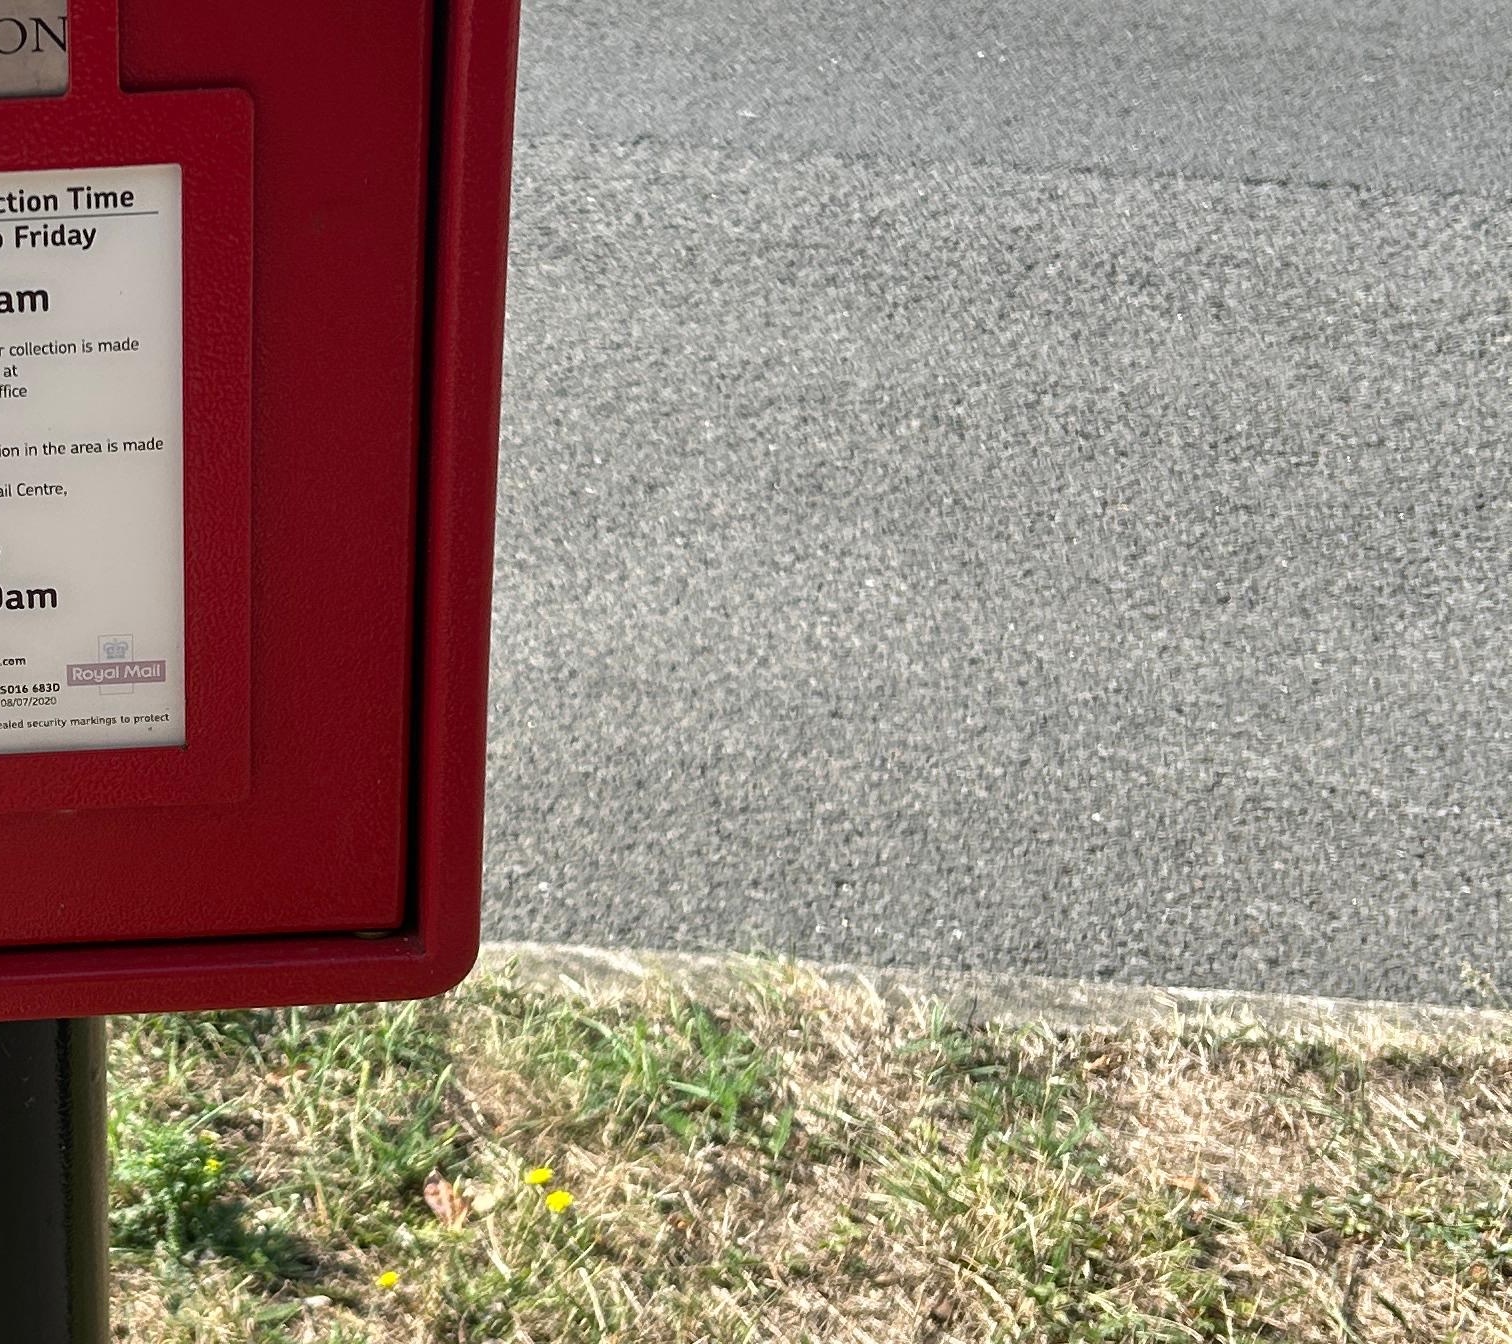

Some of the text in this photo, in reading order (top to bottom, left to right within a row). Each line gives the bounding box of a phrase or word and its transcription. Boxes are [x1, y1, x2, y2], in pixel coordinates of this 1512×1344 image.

[67, 186, 134, 210] Time
[15, 224, 97, 249] Friday
[9, 340, 77, 356] collection
[81, 339, 93, 353] is
[98, 337, 139, 352] made
[3, 365, 18, 378] at
[25, 442, 38, 456] in
[42, 442, 67, 456] the
[70, 442, 102, 454] area
[107, 439, 118, 453] is
[122, 436, 164, 452] made
[17, 482, 68, 497] Centre,
[72, 665, 161, 683] Royal Mail
[0, 696, 57, 708] 08/07/2020
[27, 717, 67, 729] security
[70, 715, 117, 727] markings
[120, 714, 130, 724] to
[134, 713, 170, 724] protect
